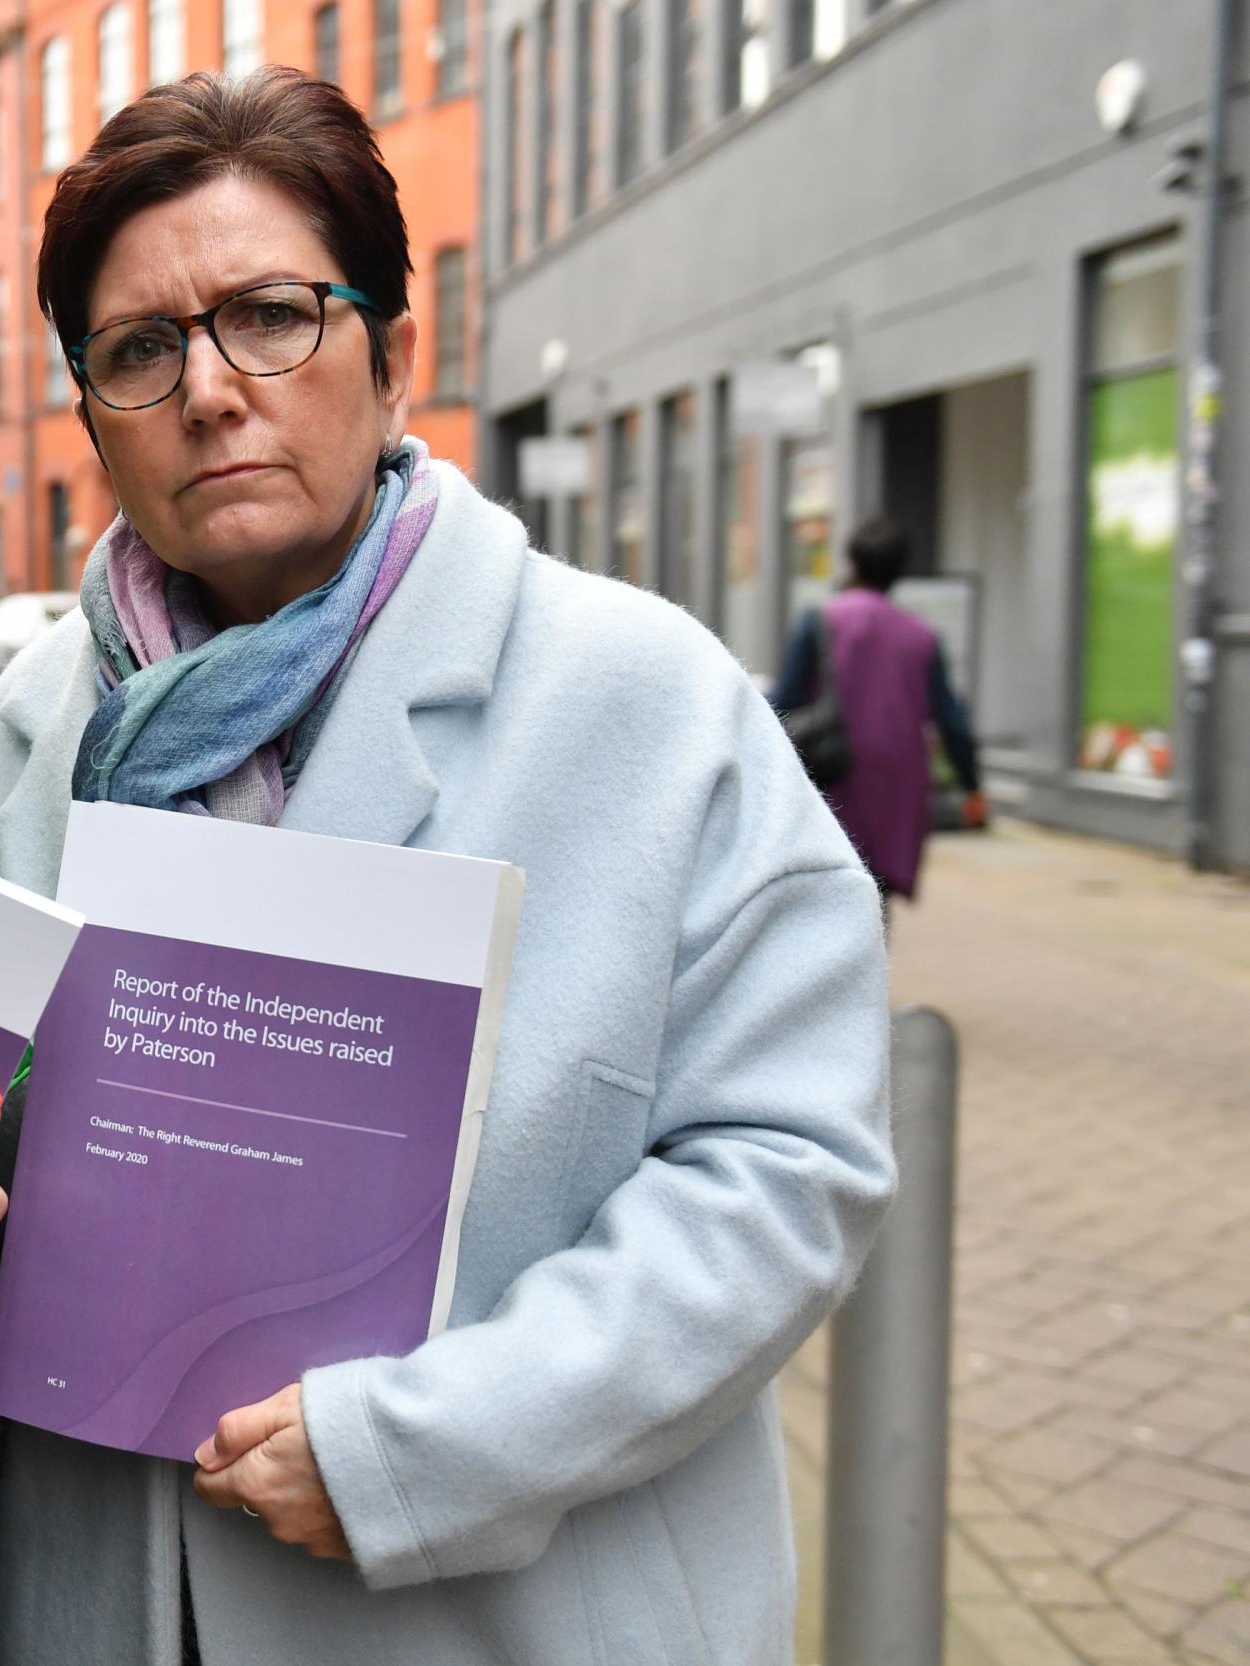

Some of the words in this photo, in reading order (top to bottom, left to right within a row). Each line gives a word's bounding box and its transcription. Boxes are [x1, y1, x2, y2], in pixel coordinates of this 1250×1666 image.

[113, 968, 178, 1000] Report
[182, 982, 206, 1003] of
[206, 985, 241, 1009] the
[245, 991, 385, 1034] Independent
[104, 1026, 128, 1054] by
[131, 1032, 216, 1068] Paterson
[108, 998, 176, 1034] Inquiry
[178, 1011, 218, 1036] into
[222, 1019, 258, 1044] the
[261, 1026, 324, 1055] Issues
[328, 1040, 394, 1067] raised
[85, 1142, 125, 1162] February
[125, 1151, 149, 1165] 2020
[90, 1115, 134, 1134] Chairman:
[137, 1125, 155, 1138] The
[156, 1130, 182, 1144] Right
[183, 1135, 229, 1153] Reverend
[230, 1144, 270, 1161] Graham
[271, 1151, 303, 1167] James
[47, 1376, 58, 1386] HC
